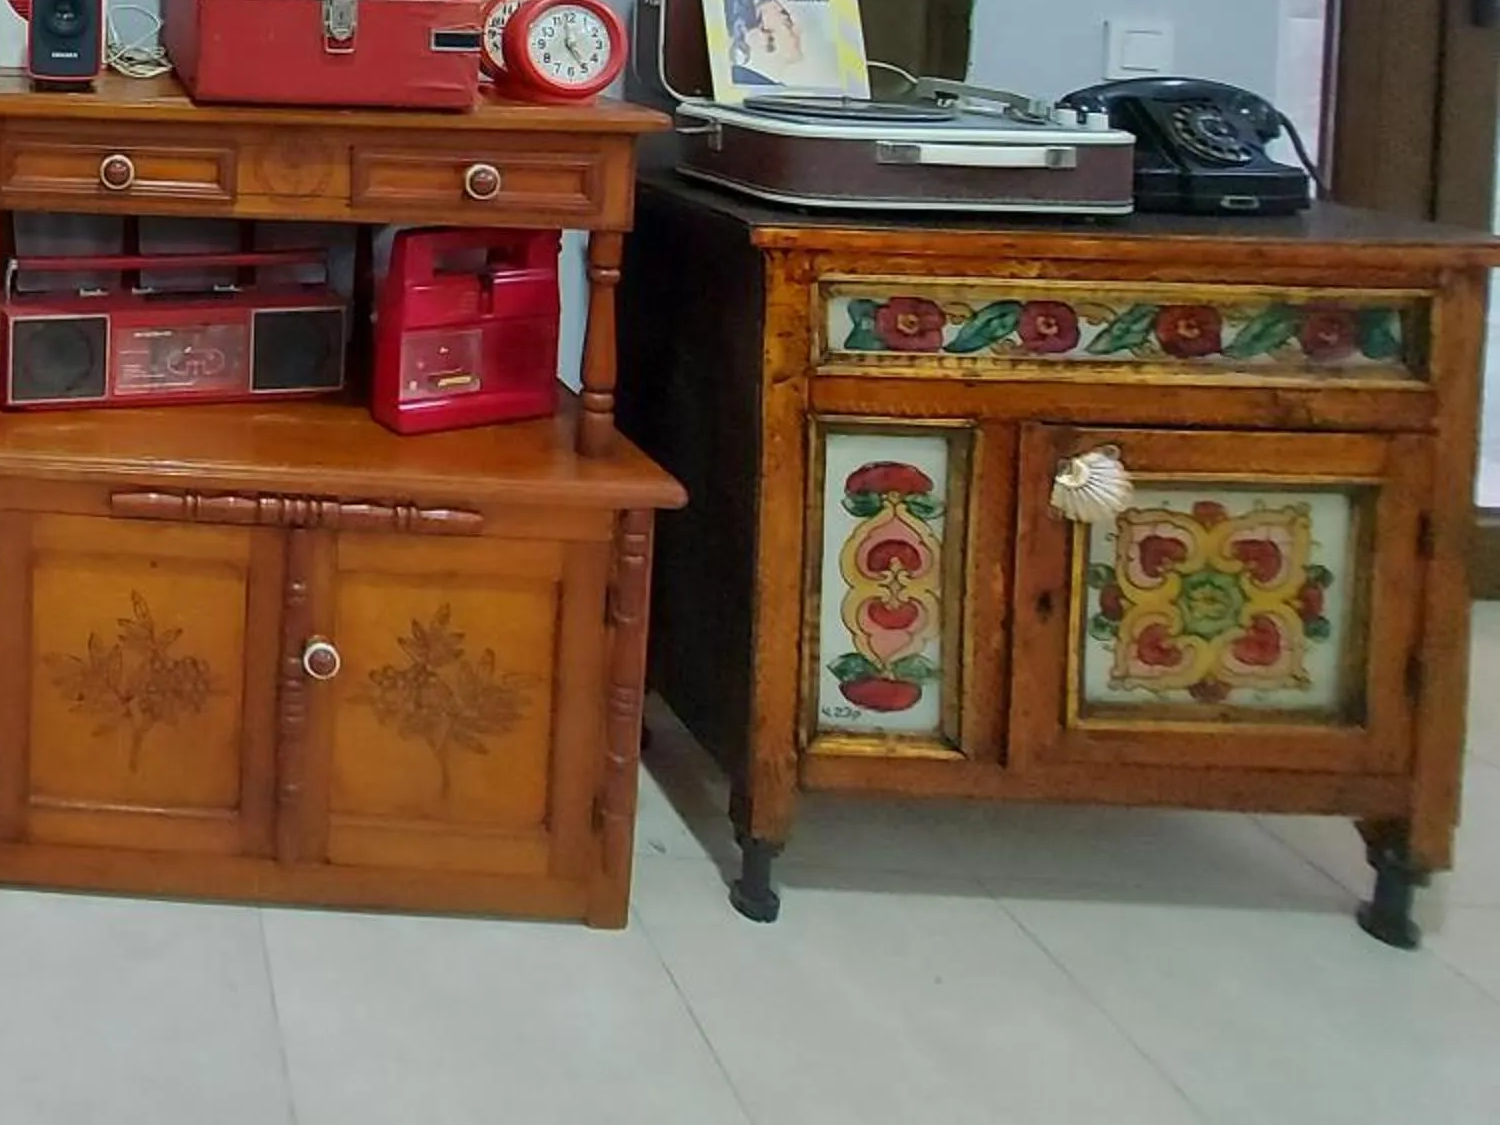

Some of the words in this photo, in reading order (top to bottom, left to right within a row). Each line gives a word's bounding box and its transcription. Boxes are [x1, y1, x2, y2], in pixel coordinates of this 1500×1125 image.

[553, 16, 563, 26] 11
[563, 12, 576, 24] 12
[542, 26, 555, 38] 10
[591, 26, 599, 38] 2
[538, 38, 546, 50] 9
[595, 39, 603, 50] 3
[543, 52, 551, 64] 8
[590, 53, 598, 63] 4
[553, 62, 562, 74] 7
[567, 66, 575, 77] 6
[580, 62, 588, 74] 5
